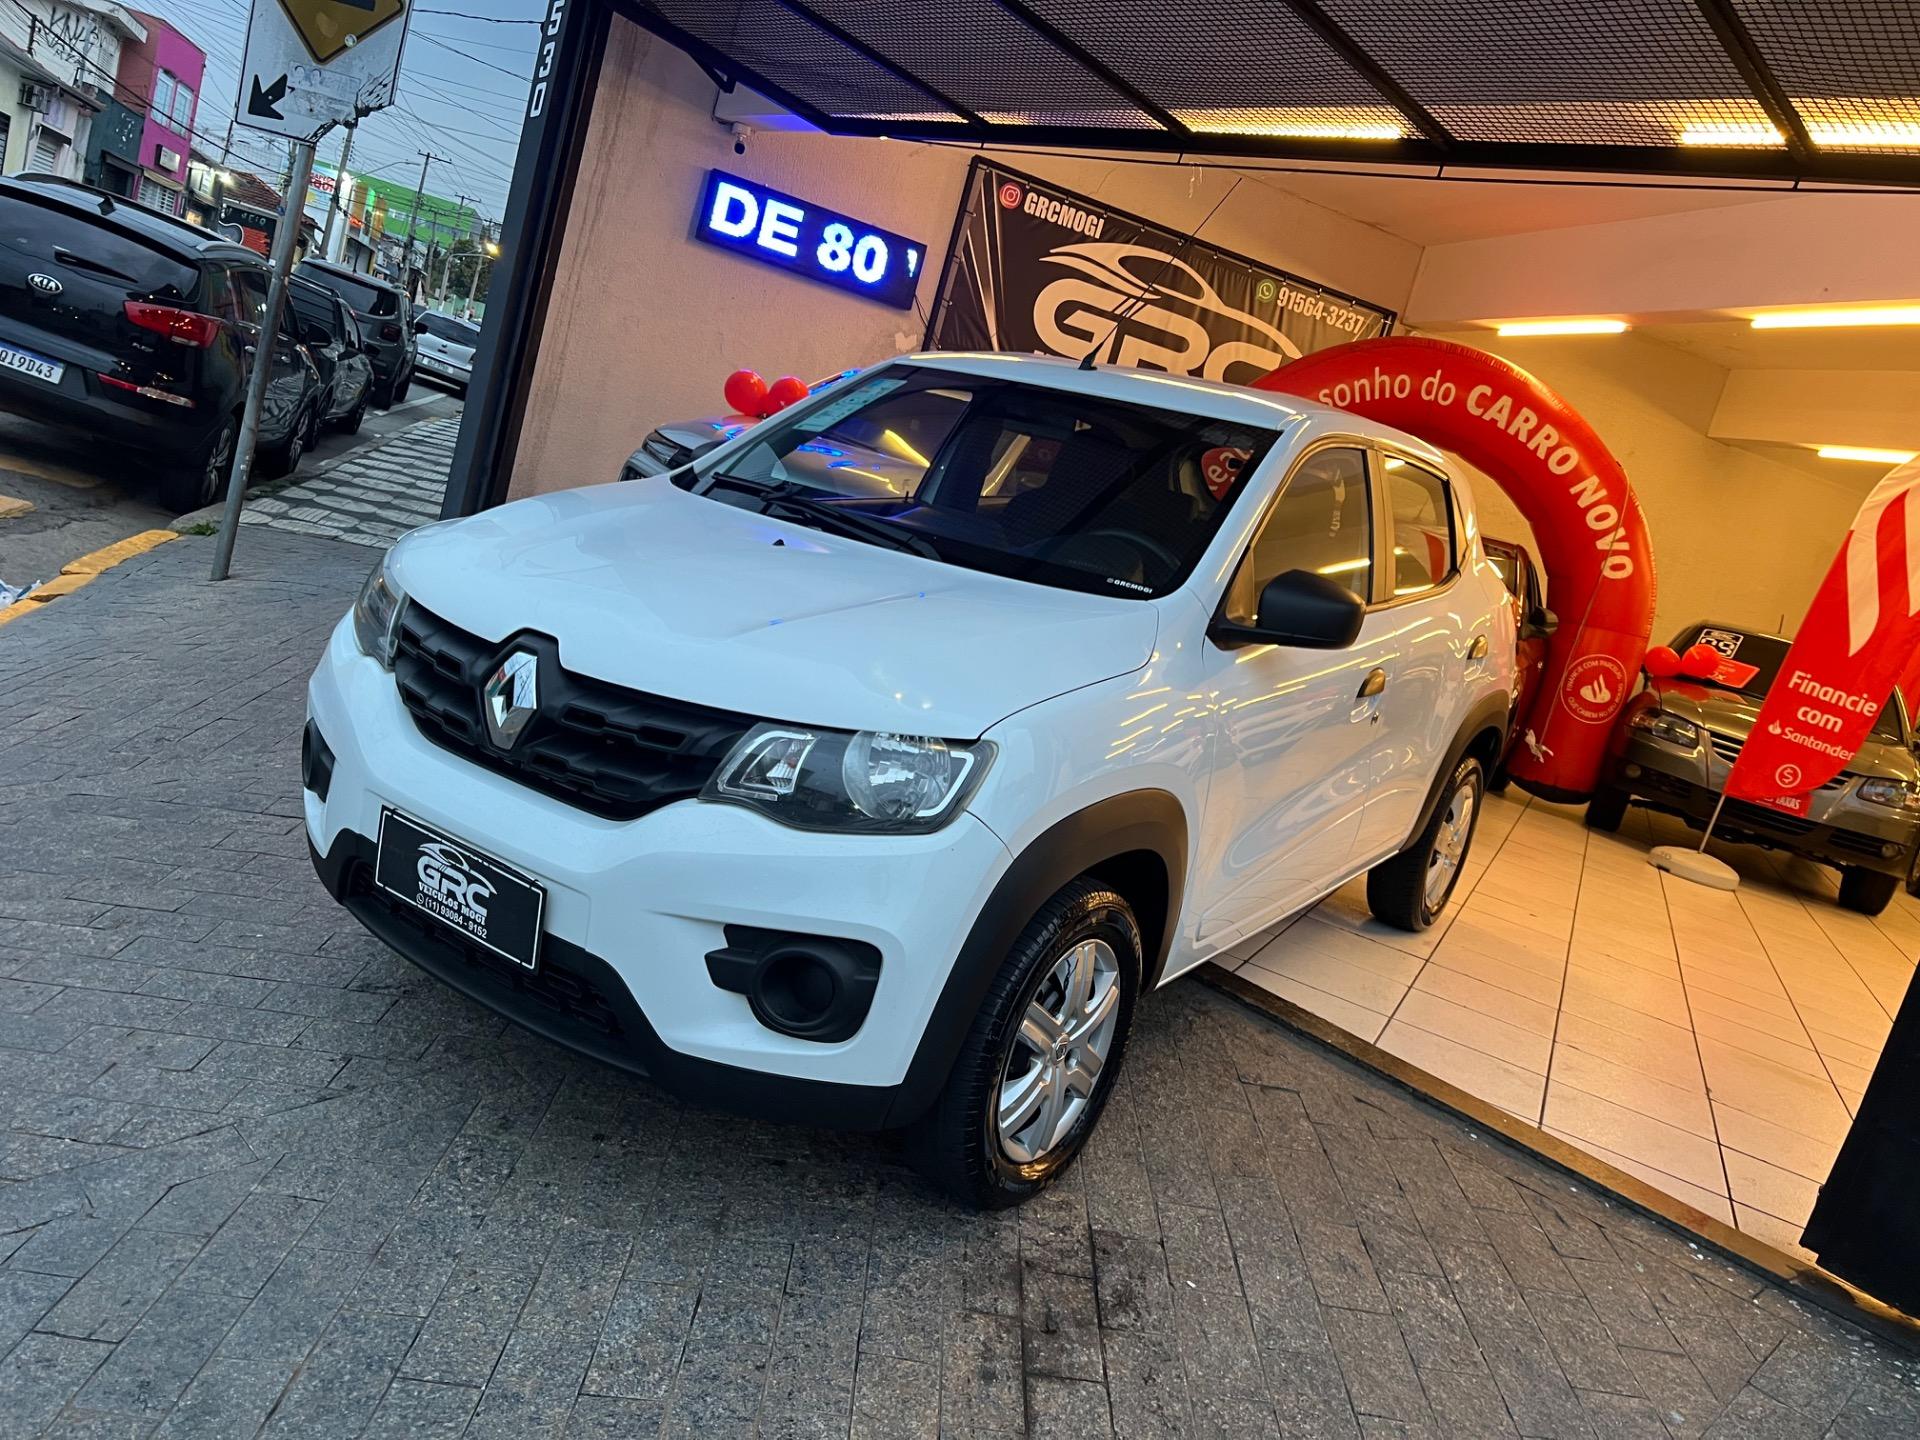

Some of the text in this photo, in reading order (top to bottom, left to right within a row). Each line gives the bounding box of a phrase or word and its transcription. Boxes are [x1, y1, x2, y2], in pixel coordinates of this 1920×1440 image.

[709, 181, 805, 257] DE
[816, 222, 889, 284] 80
[1023, 191, 1105, 240] GRCMOGI
[33, 275, 57, 292] KIA
[1276, 287, 1365, 334] 91564-3237
[1318, 366, 1634, 580] sonho do CARRO NOVO
[1788, 670, 1878, 717] Financie
[1797, 706, 1843, 733] com
[1782, 726, 1856, 761] Santander
[417, 855, 490, 917] GRC
[418, 881, 486, 926] VEICULOS MOGI
[425, 897, 440, 914] (11)
[440, 906, 463, 926] 93084
[468, 922, 488, 939] 9152
